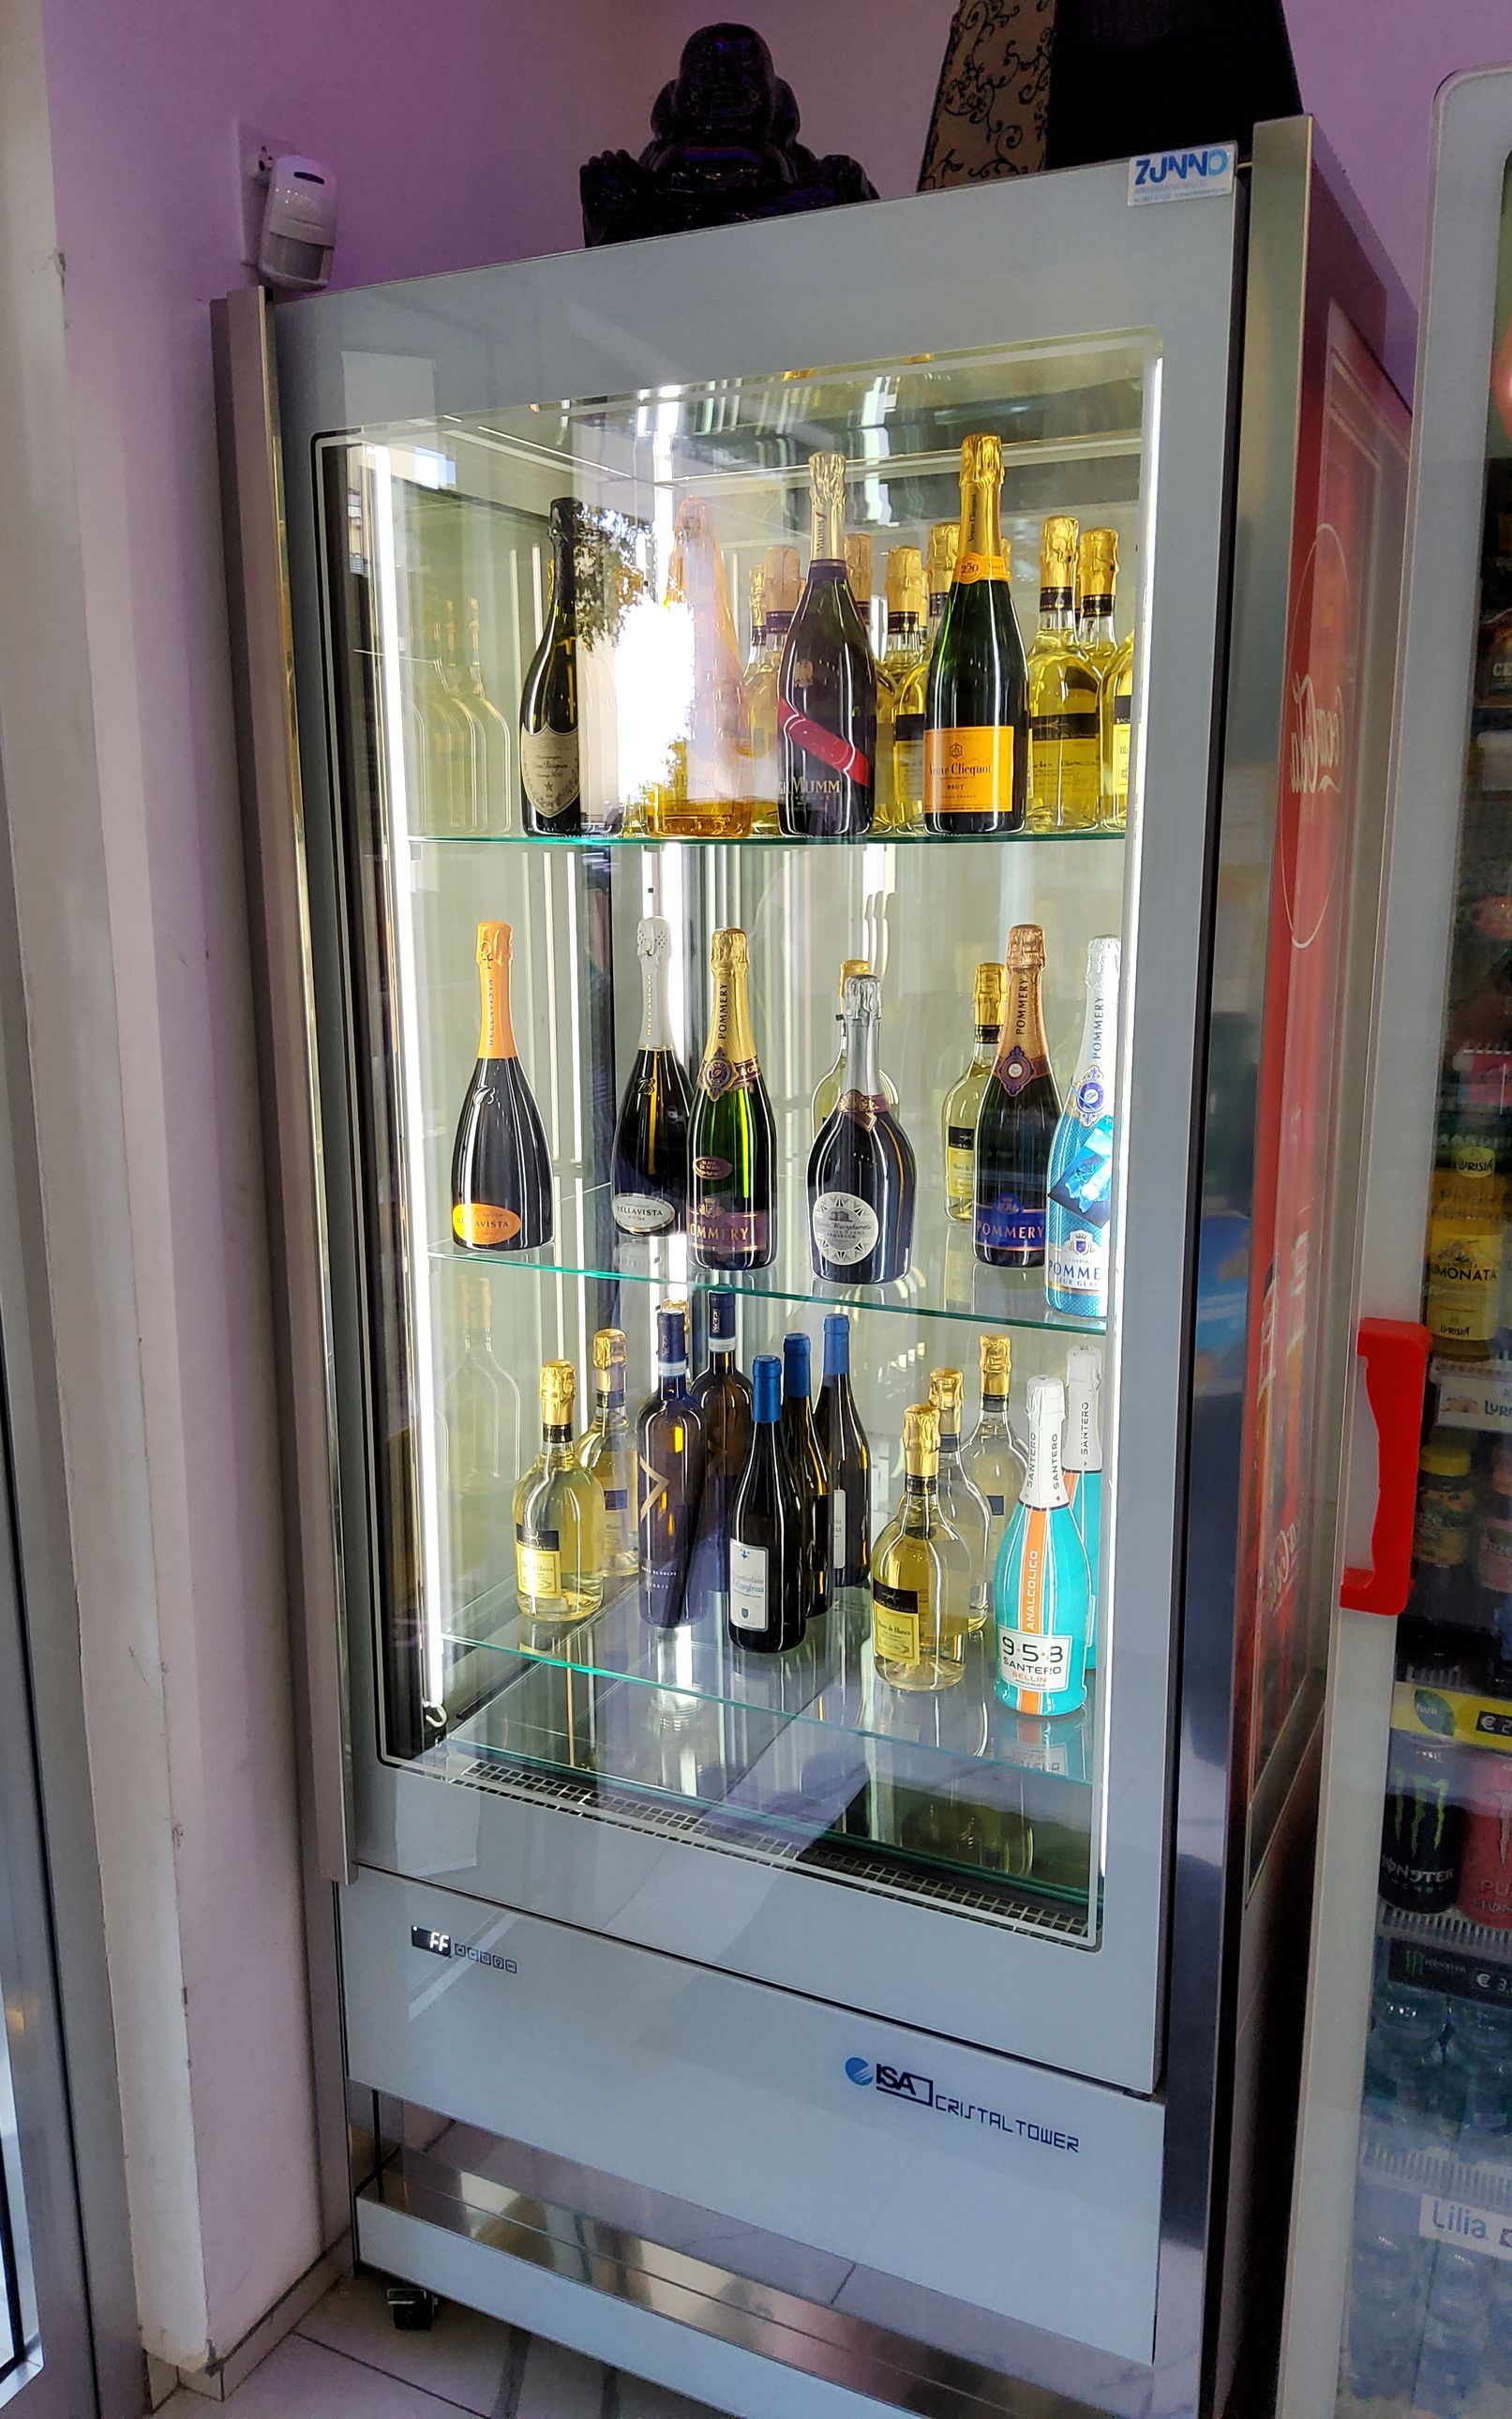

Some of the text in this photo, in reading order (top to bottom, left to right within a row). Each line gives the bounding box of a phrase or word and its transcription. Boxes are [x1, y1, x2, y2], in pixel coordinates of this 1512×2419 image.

[1135, 149, 1229, 185] ZUNNO
[961, 563, 979, 574] 250
[792, 776, 840, 794] MUMM
[930, 762, 992, 776] Veuve Clicquot
[718, 984, 728, 1040] POMMERY
[1015, 977, 1028, 1035] POMMERY
[1092, 997, 1104, 1059] POMMERY
[690, 1223, 749, 1240] OMMERY
[977, 1222, 1044, 1240] POMMERY
[1049, 1259, 1101, 1281] POMME
[1081, 1402, 1089, 1455] SANTERO
[1027, 1432, 1037, 1489] SANTERO
[1052, 1434, 1060, 1490] SANTERO
[1026, 1550, 1039, 1630] ANALCOLICO
[1003, 1656, 1062, 1675] SANTERO
[1011, 1671, 1047, 1684] BELLIN
[1476, 1973, 1491, 1989] €
[876, 2063, 1079, 2154] ISA CRISTAL TOWER
[1432, 2200, 1487, 2239] Lilia
